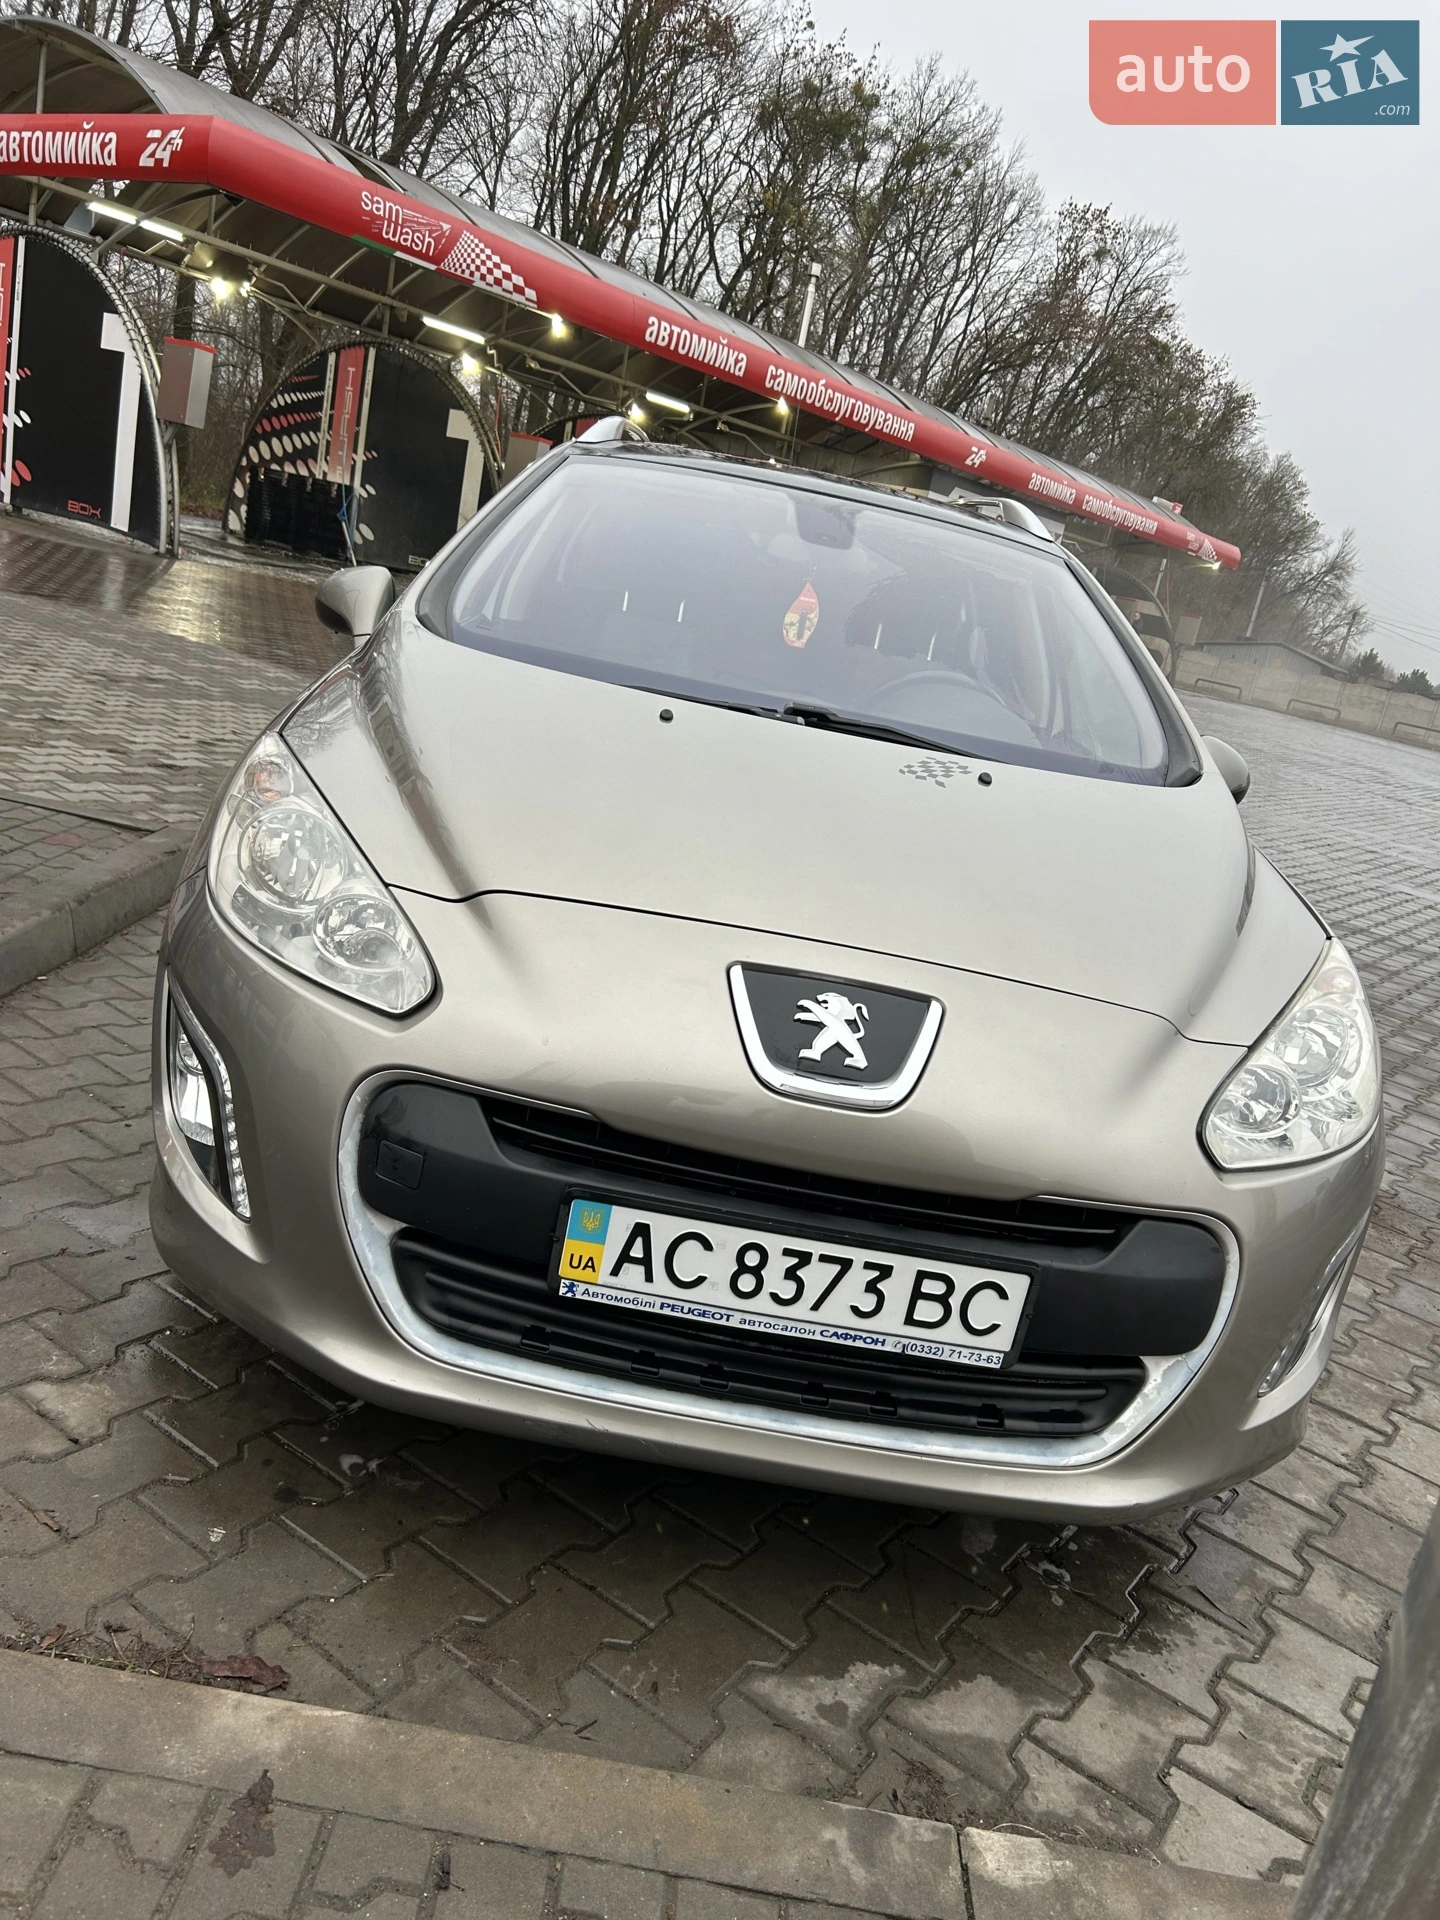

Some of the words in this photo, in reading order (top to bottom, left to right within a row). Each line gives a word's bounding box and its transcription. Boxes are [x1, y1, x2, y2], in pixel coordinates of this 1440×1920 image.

[0, 120, 117, 167] автомийка
[361, 191, 403, 224] sam
[382, 219, 435, 257] wash
[644, 316, 747, 378] автомийка
[765, 364, 915, 443] самообслуговування
[67, 500, 102, 519] BOX
[1028, 471, 1076, 505] автомийка
[1081, 493, 1158, 536] самообслуговування
[568, 1253, 597, 1273] UA
[609, 1221, 714, 1289] AC
[729, 1241, 894, 1319] 8373
[903, 1269, 1010, 1337] BC
[581, 1287, 656, 1310] Автомобілі
[659, 1301, 734, 1323] PEUGEOT
[739, 1317, 816, 1336] автосалон
[819, 1329, 887, 1347] САФРОН
[905, 1341, 944, 1358] (0332)
[948, 1348, 1002, 1366] 71-73-63
